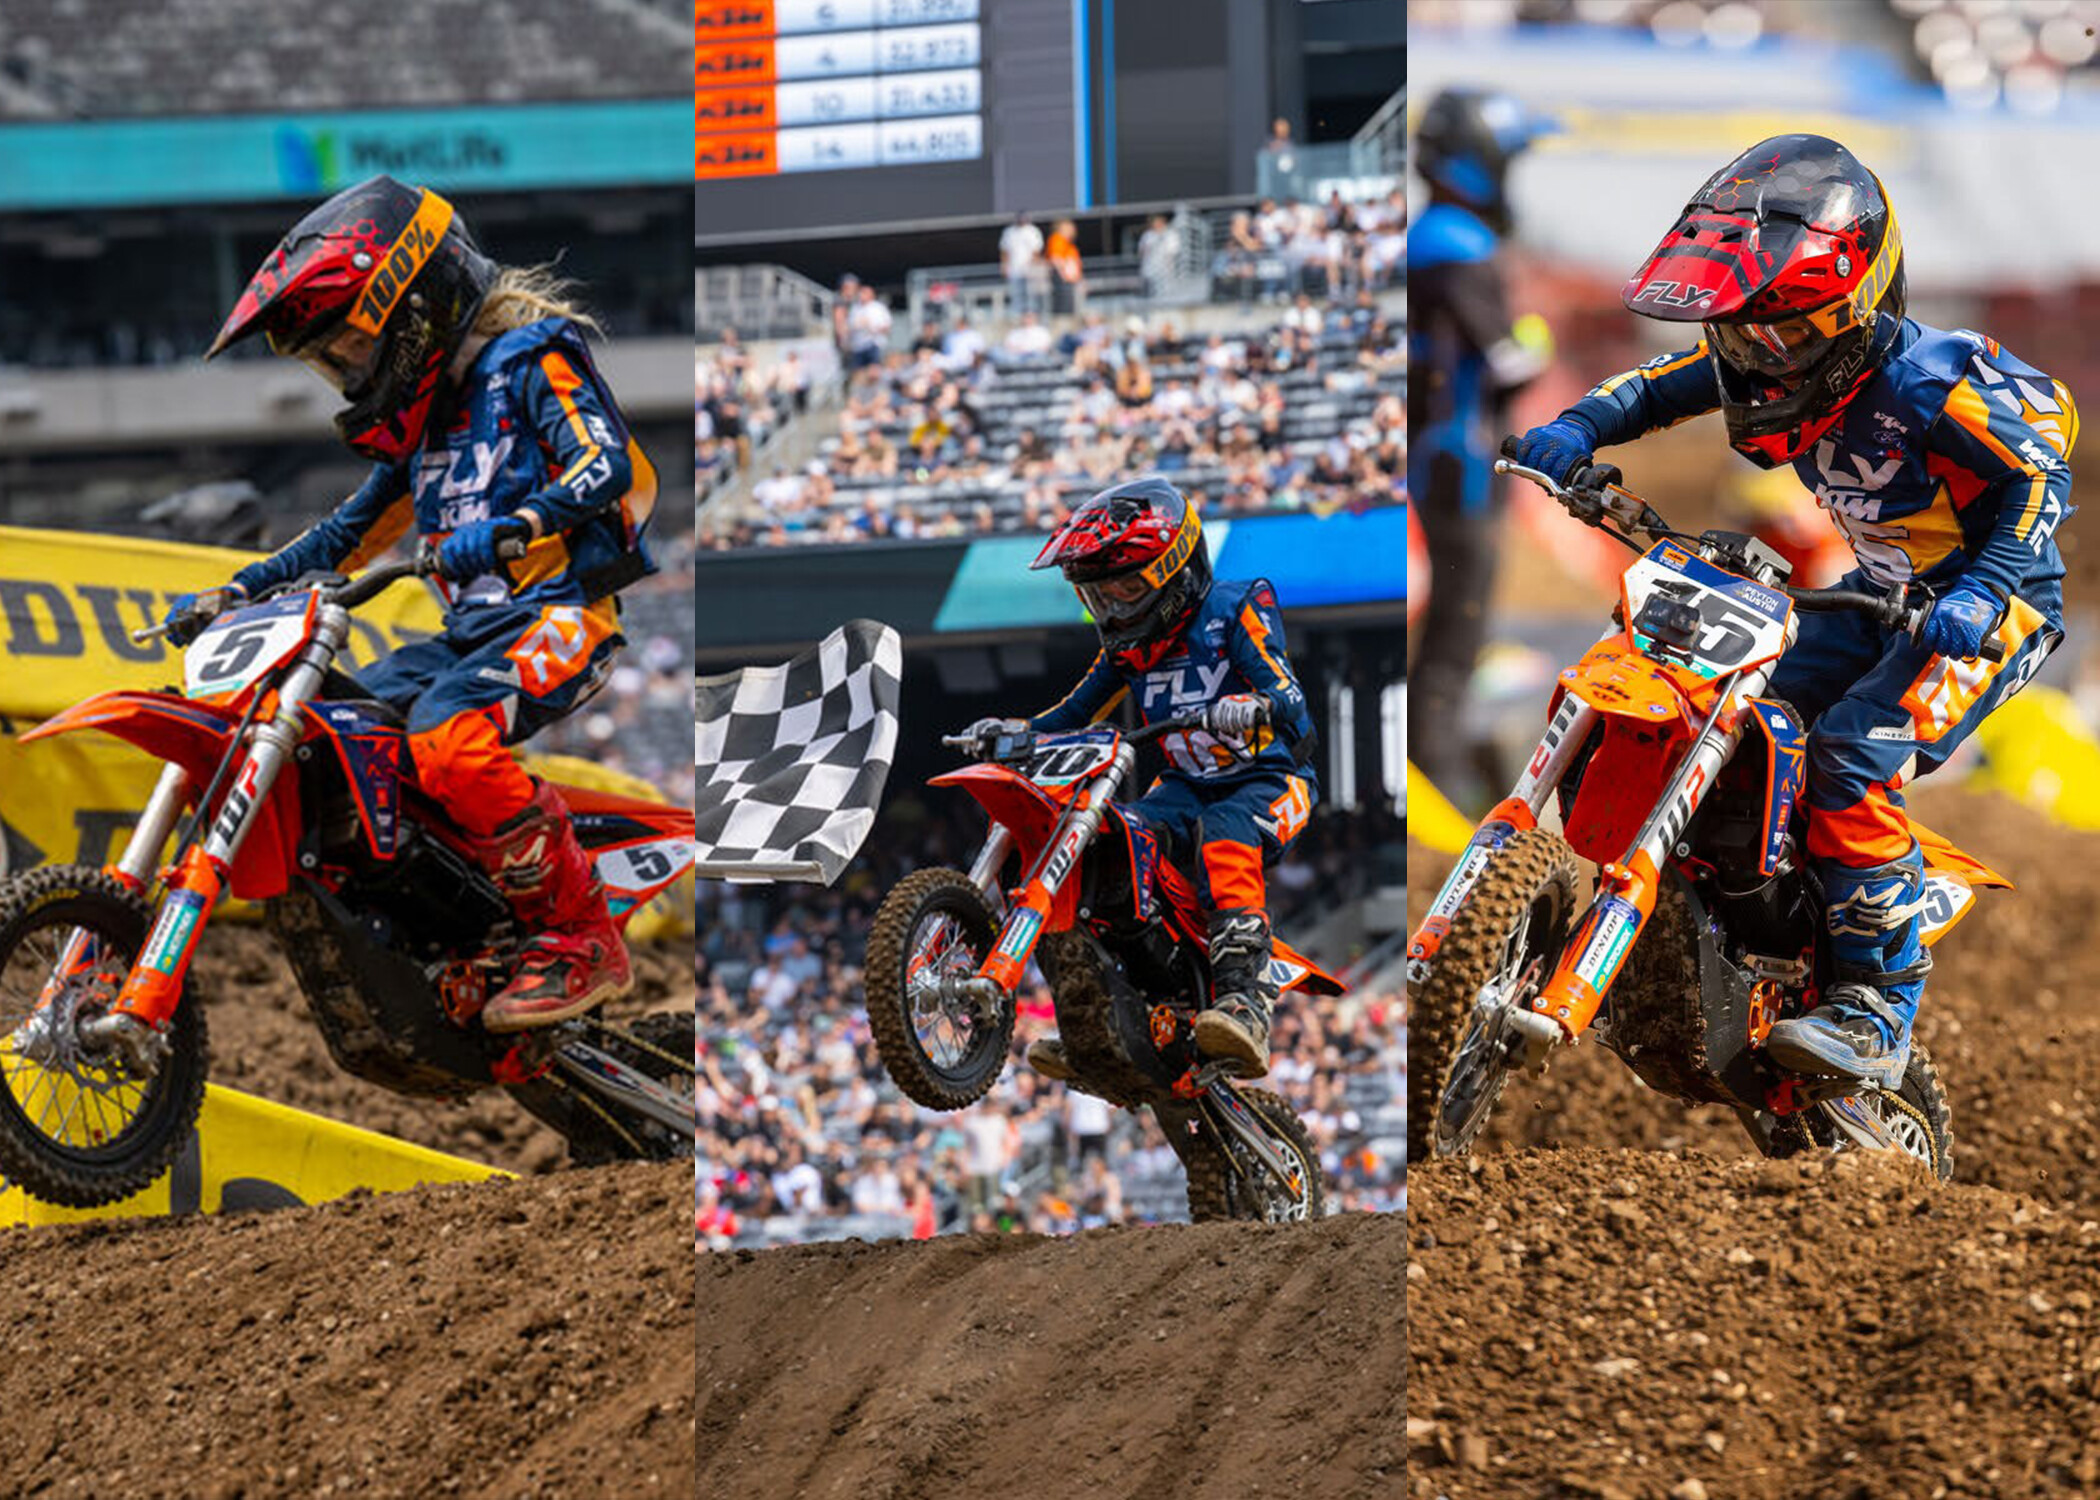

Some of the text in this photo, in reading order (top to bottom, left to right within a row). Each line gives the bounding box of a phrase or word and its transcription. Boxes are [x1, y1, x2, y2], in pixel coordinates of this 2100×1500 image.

[359, 220, 436, 326] 100%
[1633, 280, 1718, 308] FLY
[1826, 329, 1874, 395] FLY
[415, 434, 518, 500] FLY
[570, 455, 612, 503] FLY
[1816, 438, 1904, 491] LY
[1815, 483, 1882, 521] KTM
[2028, 489, 2062, 557] FLY
[1150, 522, 1199, 583] 100%
[1742, 593, 1776, 613] AUSTIN
[1744, 586, 1780, 608] PEYTON
[197, 621, 277, 682] 5
[1143, 659, 1230, 708] FLY
[214, 756, 260, 847] WP
[1658, 763, 1706, 857] WP
[623, 847, 672, 882] 5
[1049, 831, 1079, 886] WP
[1442, 860, 1477, 915] DNLOP
[1588, 914, 1620, 968] DUNLOP
[1602, 928, 1633, 977] MOTOREX
